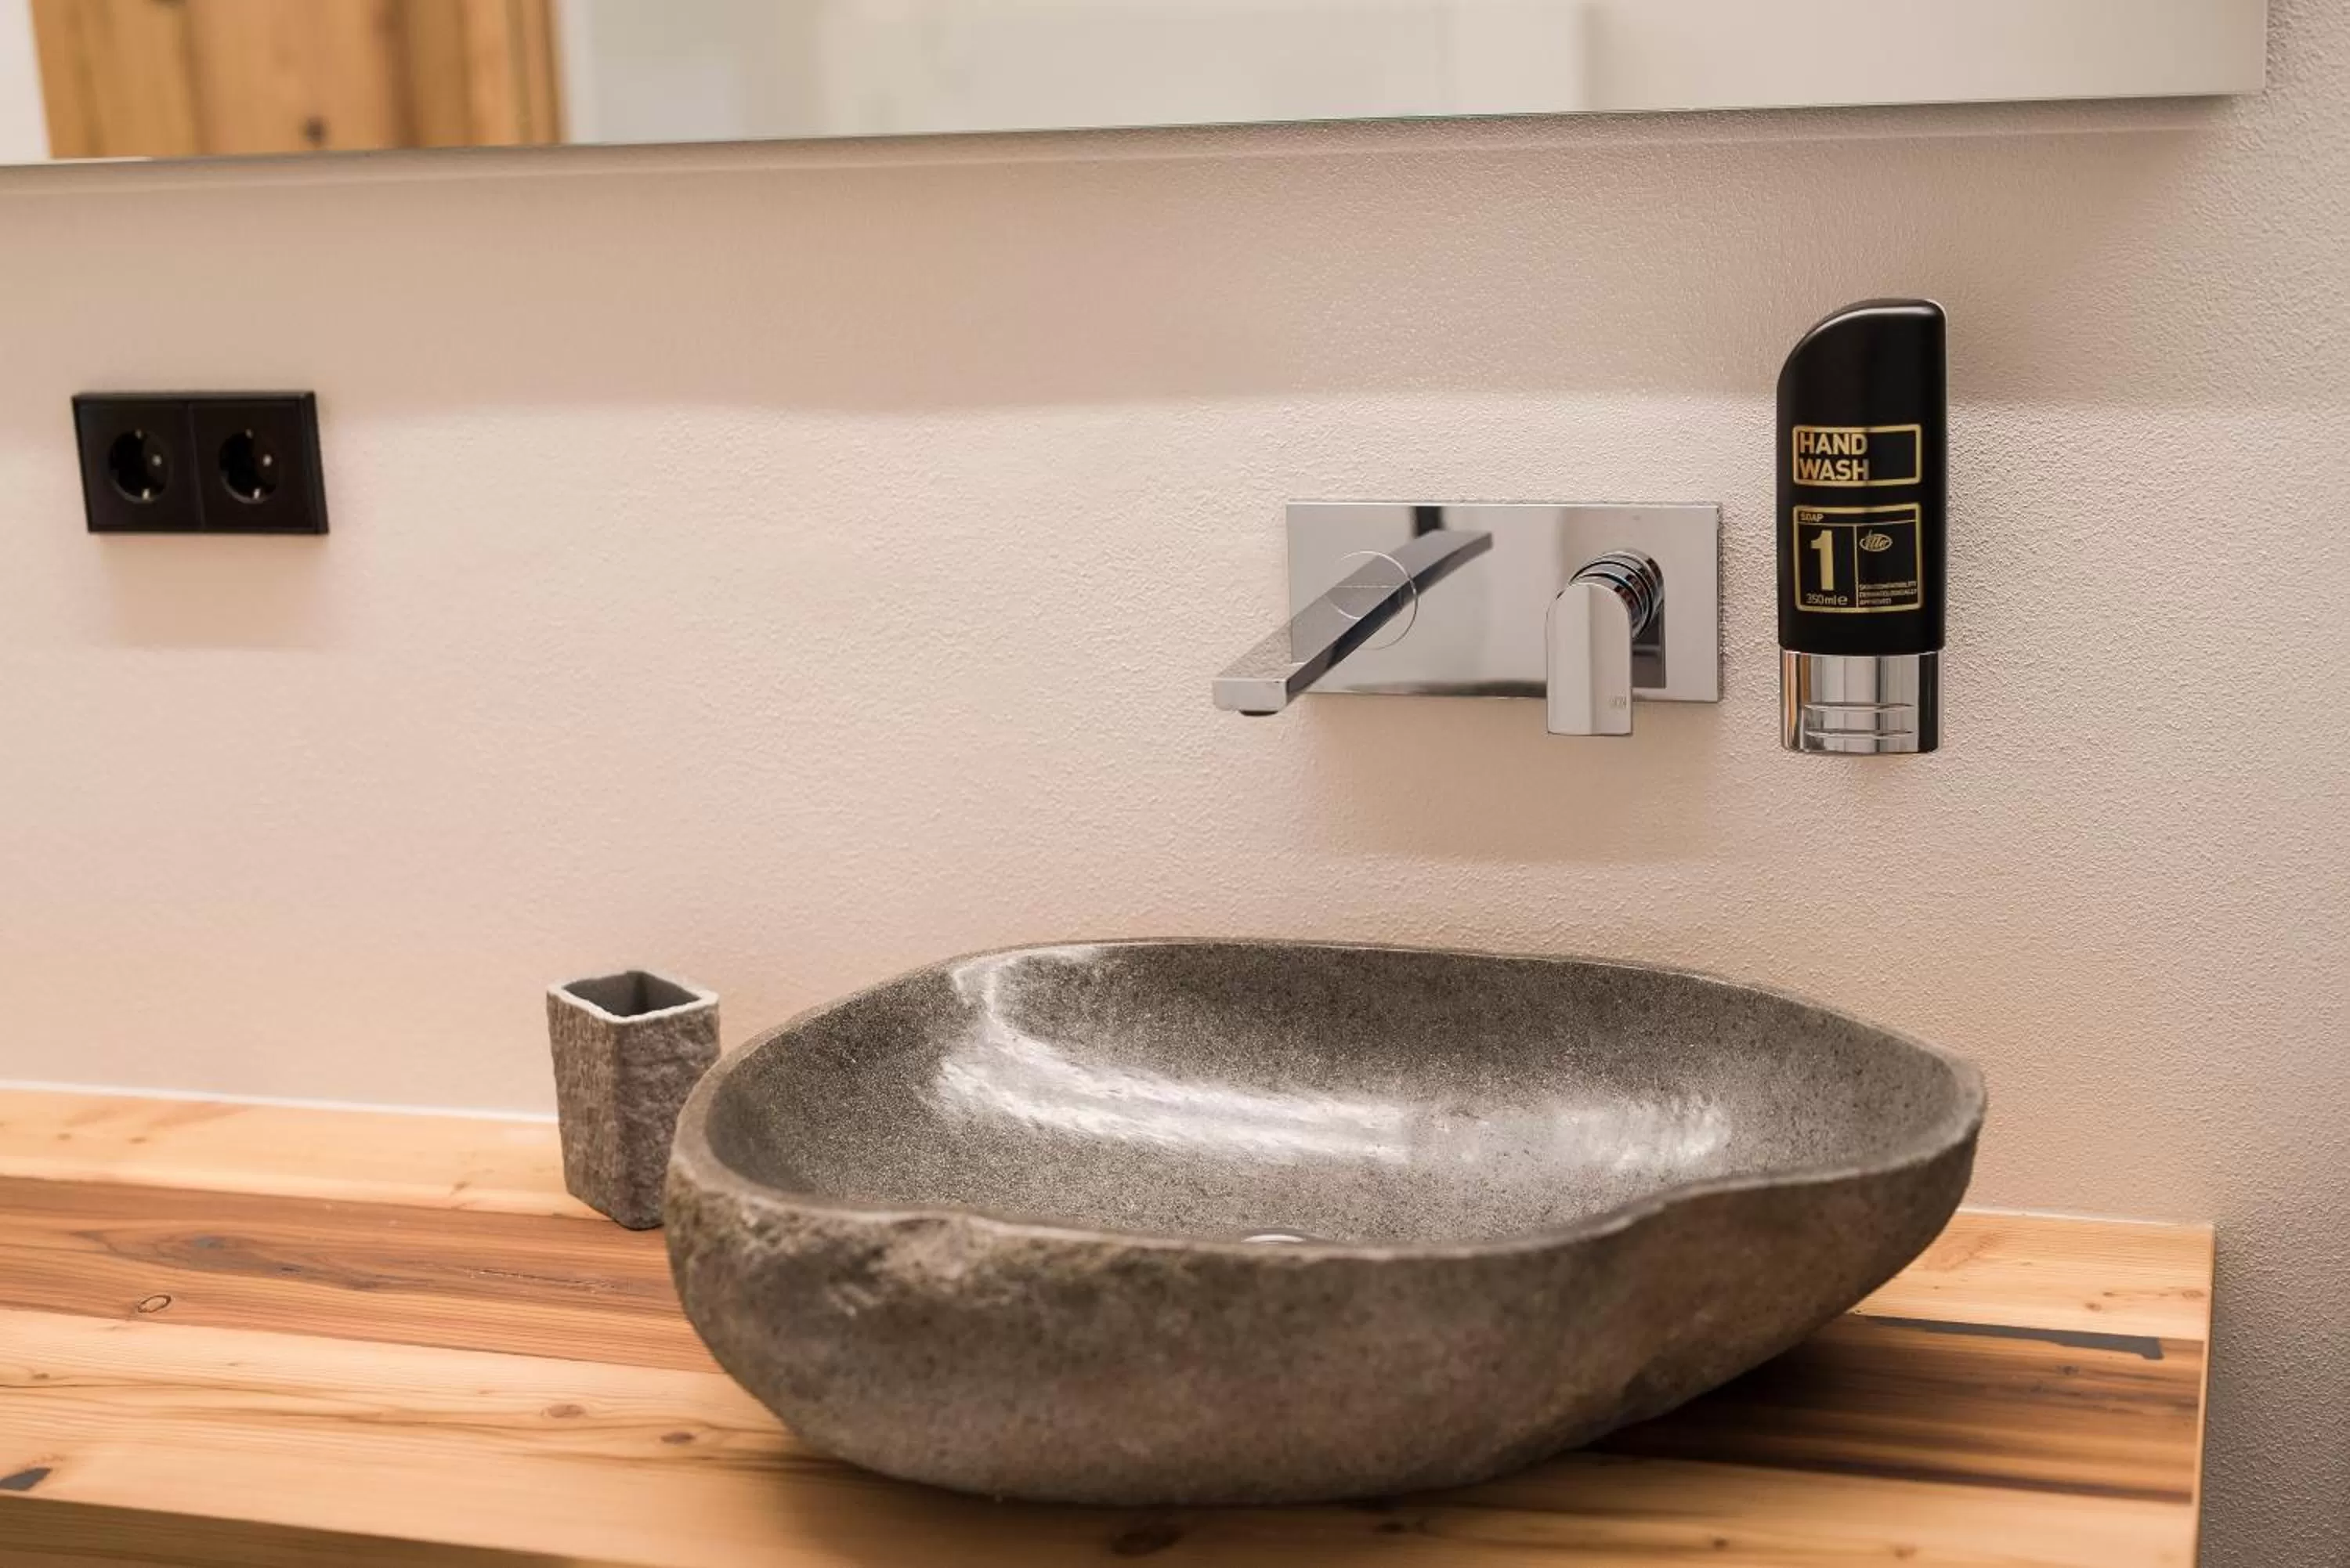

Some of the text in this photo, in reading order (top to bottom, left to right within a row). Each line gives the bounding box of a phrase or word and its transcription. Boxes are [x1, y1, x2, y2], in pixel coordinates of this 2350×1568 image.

[1800, 432, 1867, 454] HAND
[1799, 458, 1870, 480] WASH
[1799, 513, 1824, 522] SOAP
[1811, 529, 1834, 591] 1
